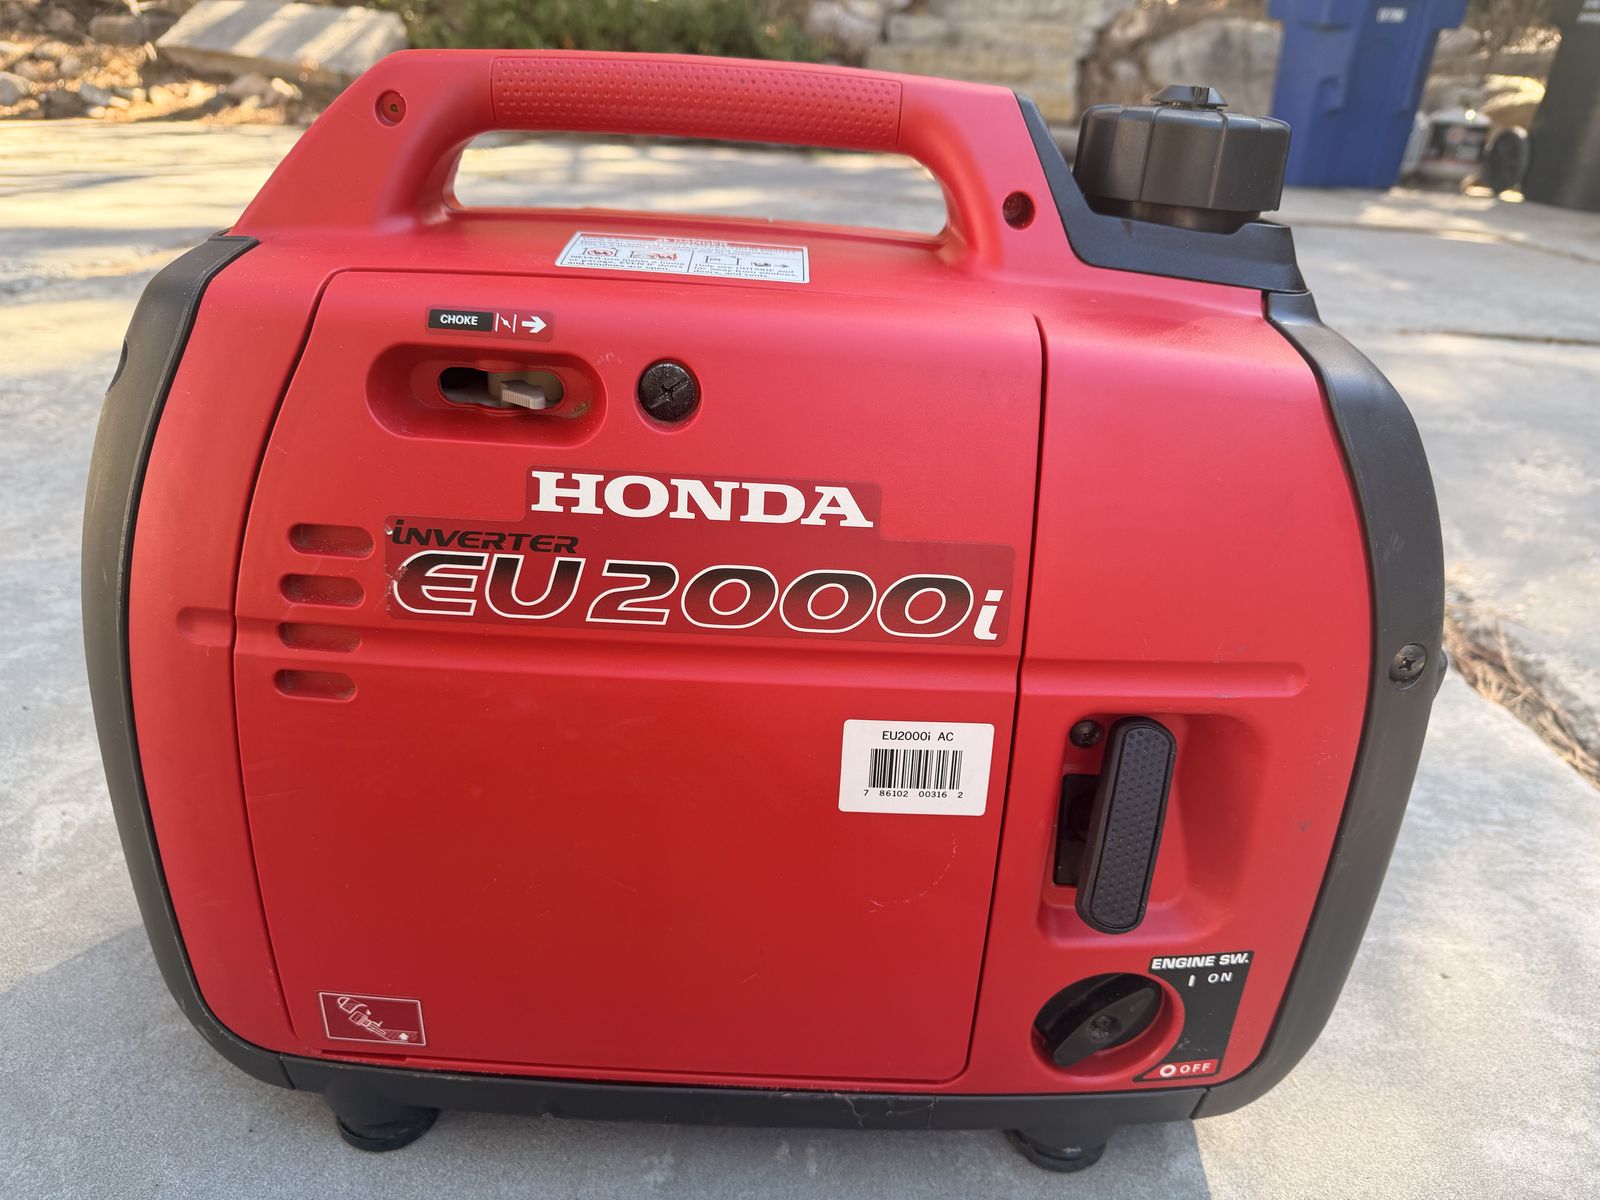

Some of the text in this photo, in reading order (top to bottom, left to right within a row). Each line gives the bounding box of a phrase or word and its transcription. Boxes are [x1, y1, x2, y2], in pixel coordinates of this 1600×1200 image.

[440, 314, 478, 326] CHOKE
[531, 470, 873, 528] HONDA
[882, 730, 954, 742] EU2000i AC
[863, 789, 964, 799] 7 86102 00316 2
[1151, 952, 1250, 970] ENGINE SW.
[1207, 971, 1233, 984] ON
[1179, 1062, 1212, 1075] OFF
